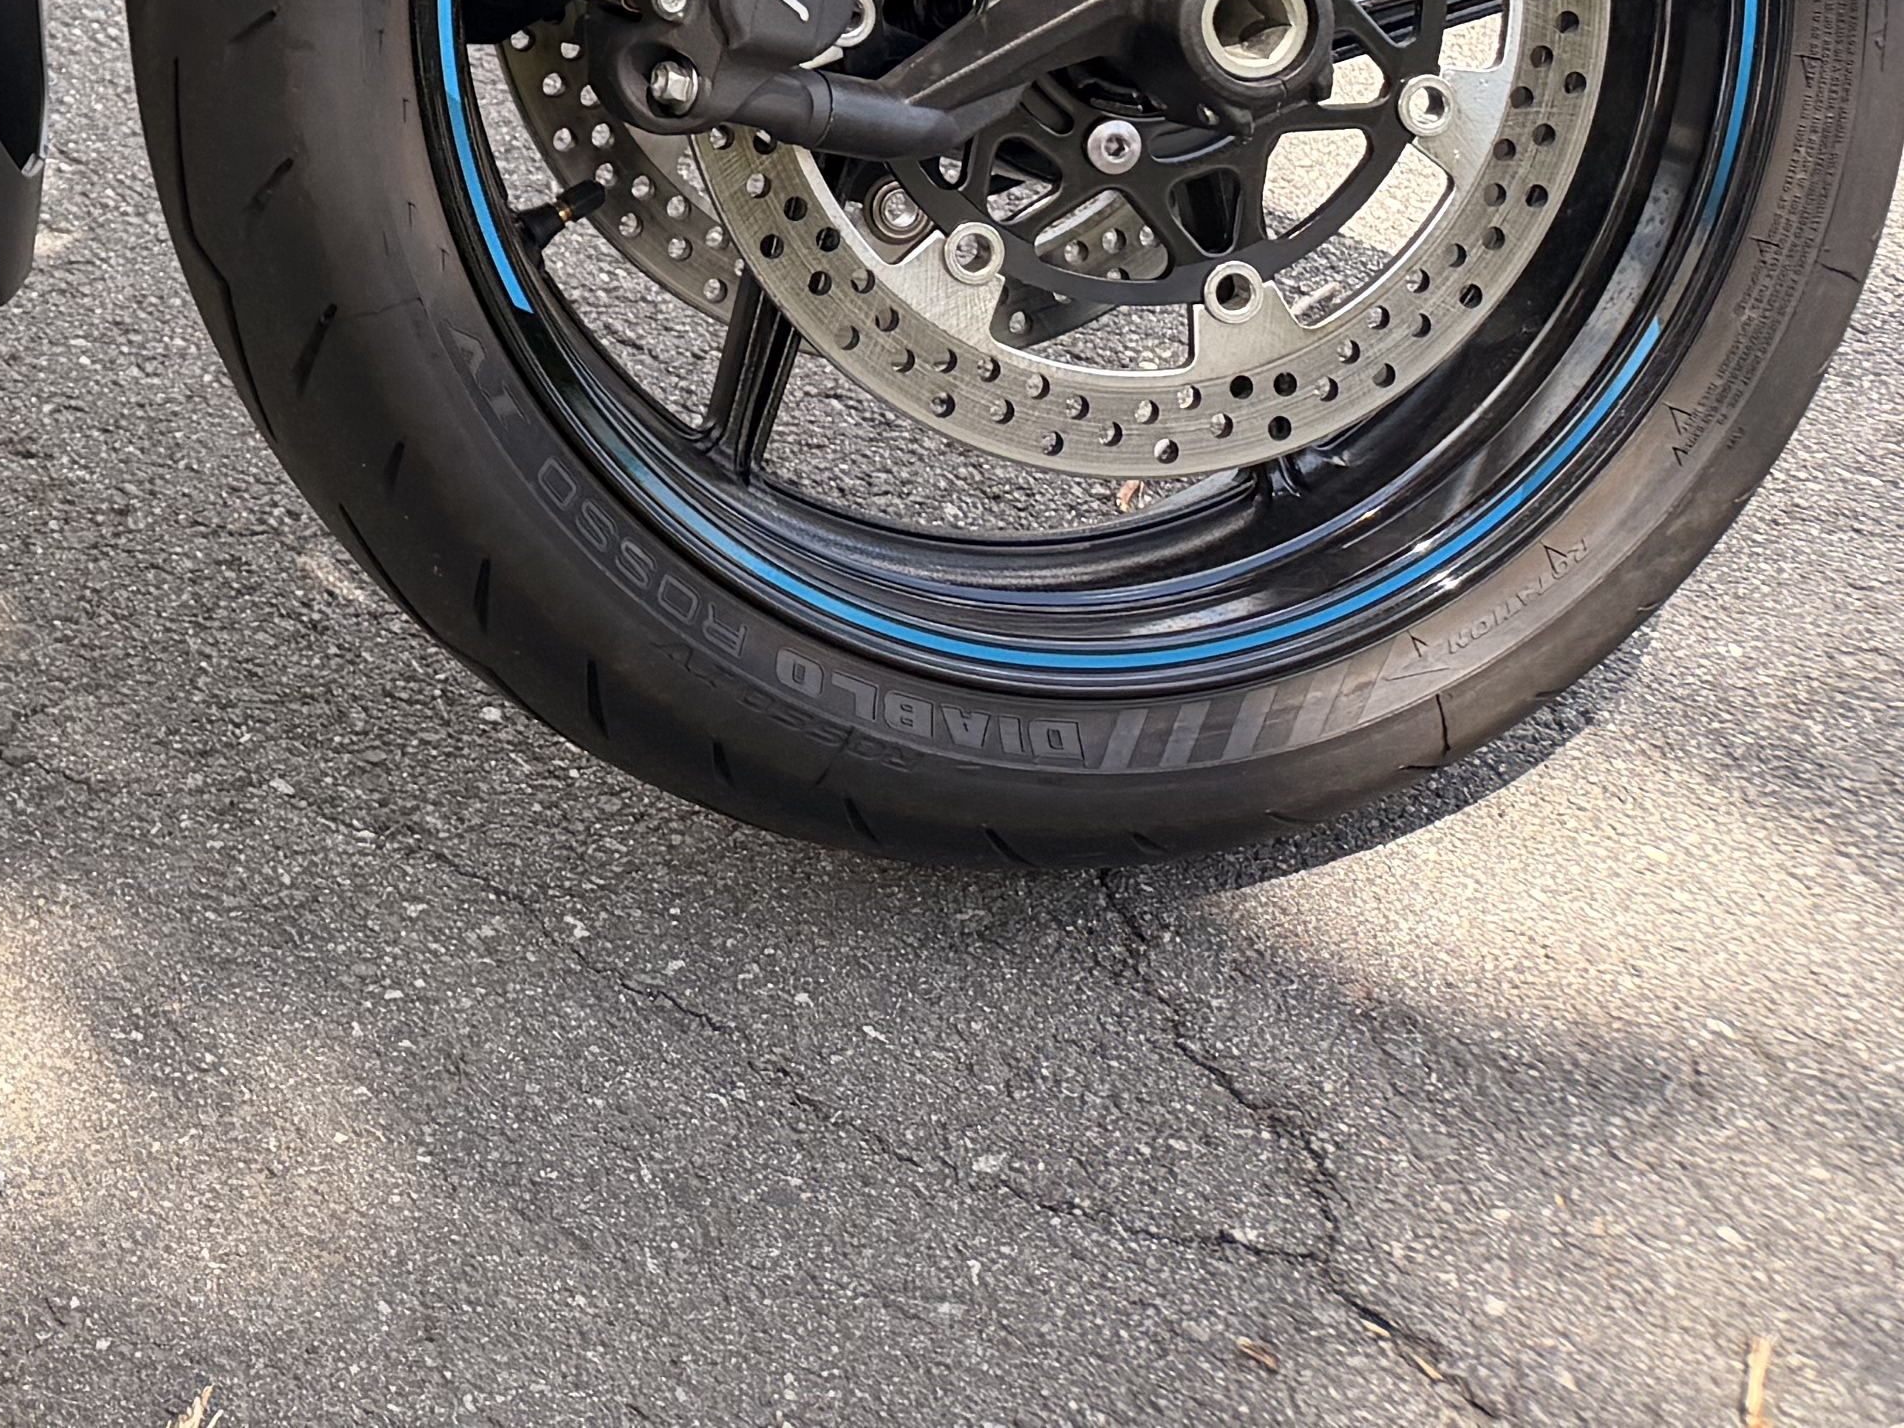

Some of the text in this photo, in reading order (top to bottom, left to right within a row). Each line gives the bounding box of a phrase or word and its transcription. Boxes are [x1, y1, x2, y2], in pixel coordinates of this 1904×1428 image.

[446, 323, 1084, 760] DIABLO ROSSO IV
